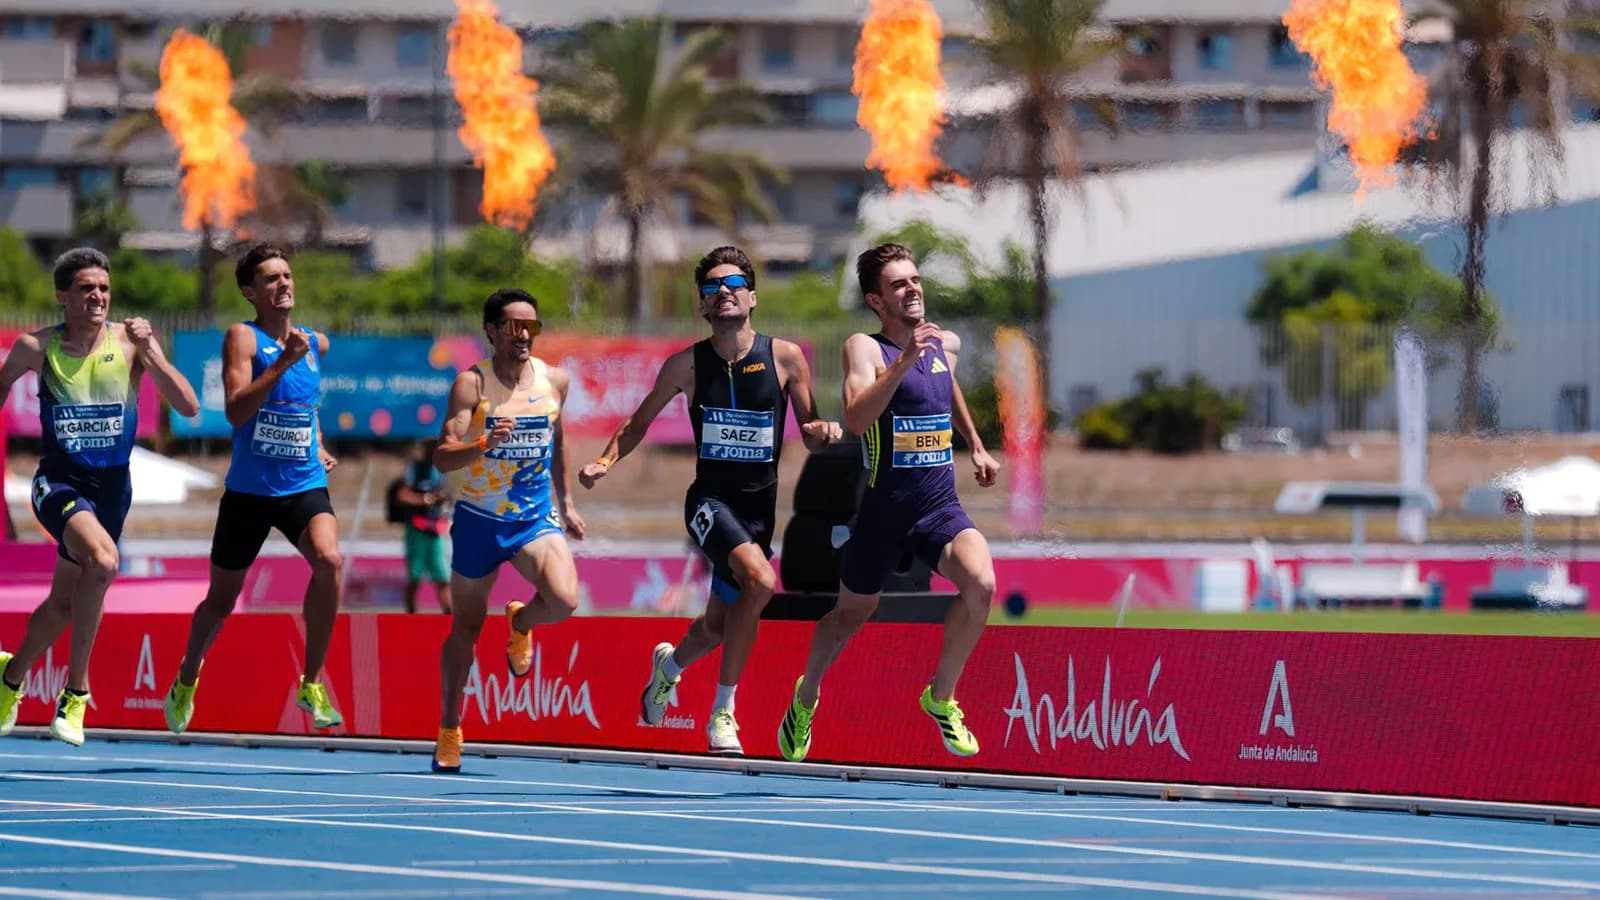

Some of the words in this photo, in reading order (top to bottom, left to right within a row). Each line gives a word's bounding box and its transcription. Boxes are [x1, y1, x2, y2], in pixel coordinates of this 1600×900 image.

[743, 362, 766, 374] HOKA
[720, 428, 758, 442] SAEZ
[916, 436, 940, 448] BEN
[459, 640, 600, 729] Andalucía
[1003, 651, 1192, 761] Andalucía
[1238, 744, 1263, 760] Junta
[1264, 743, 1275, 760] de
[1275, 744, 1318, 763] Andalucía
